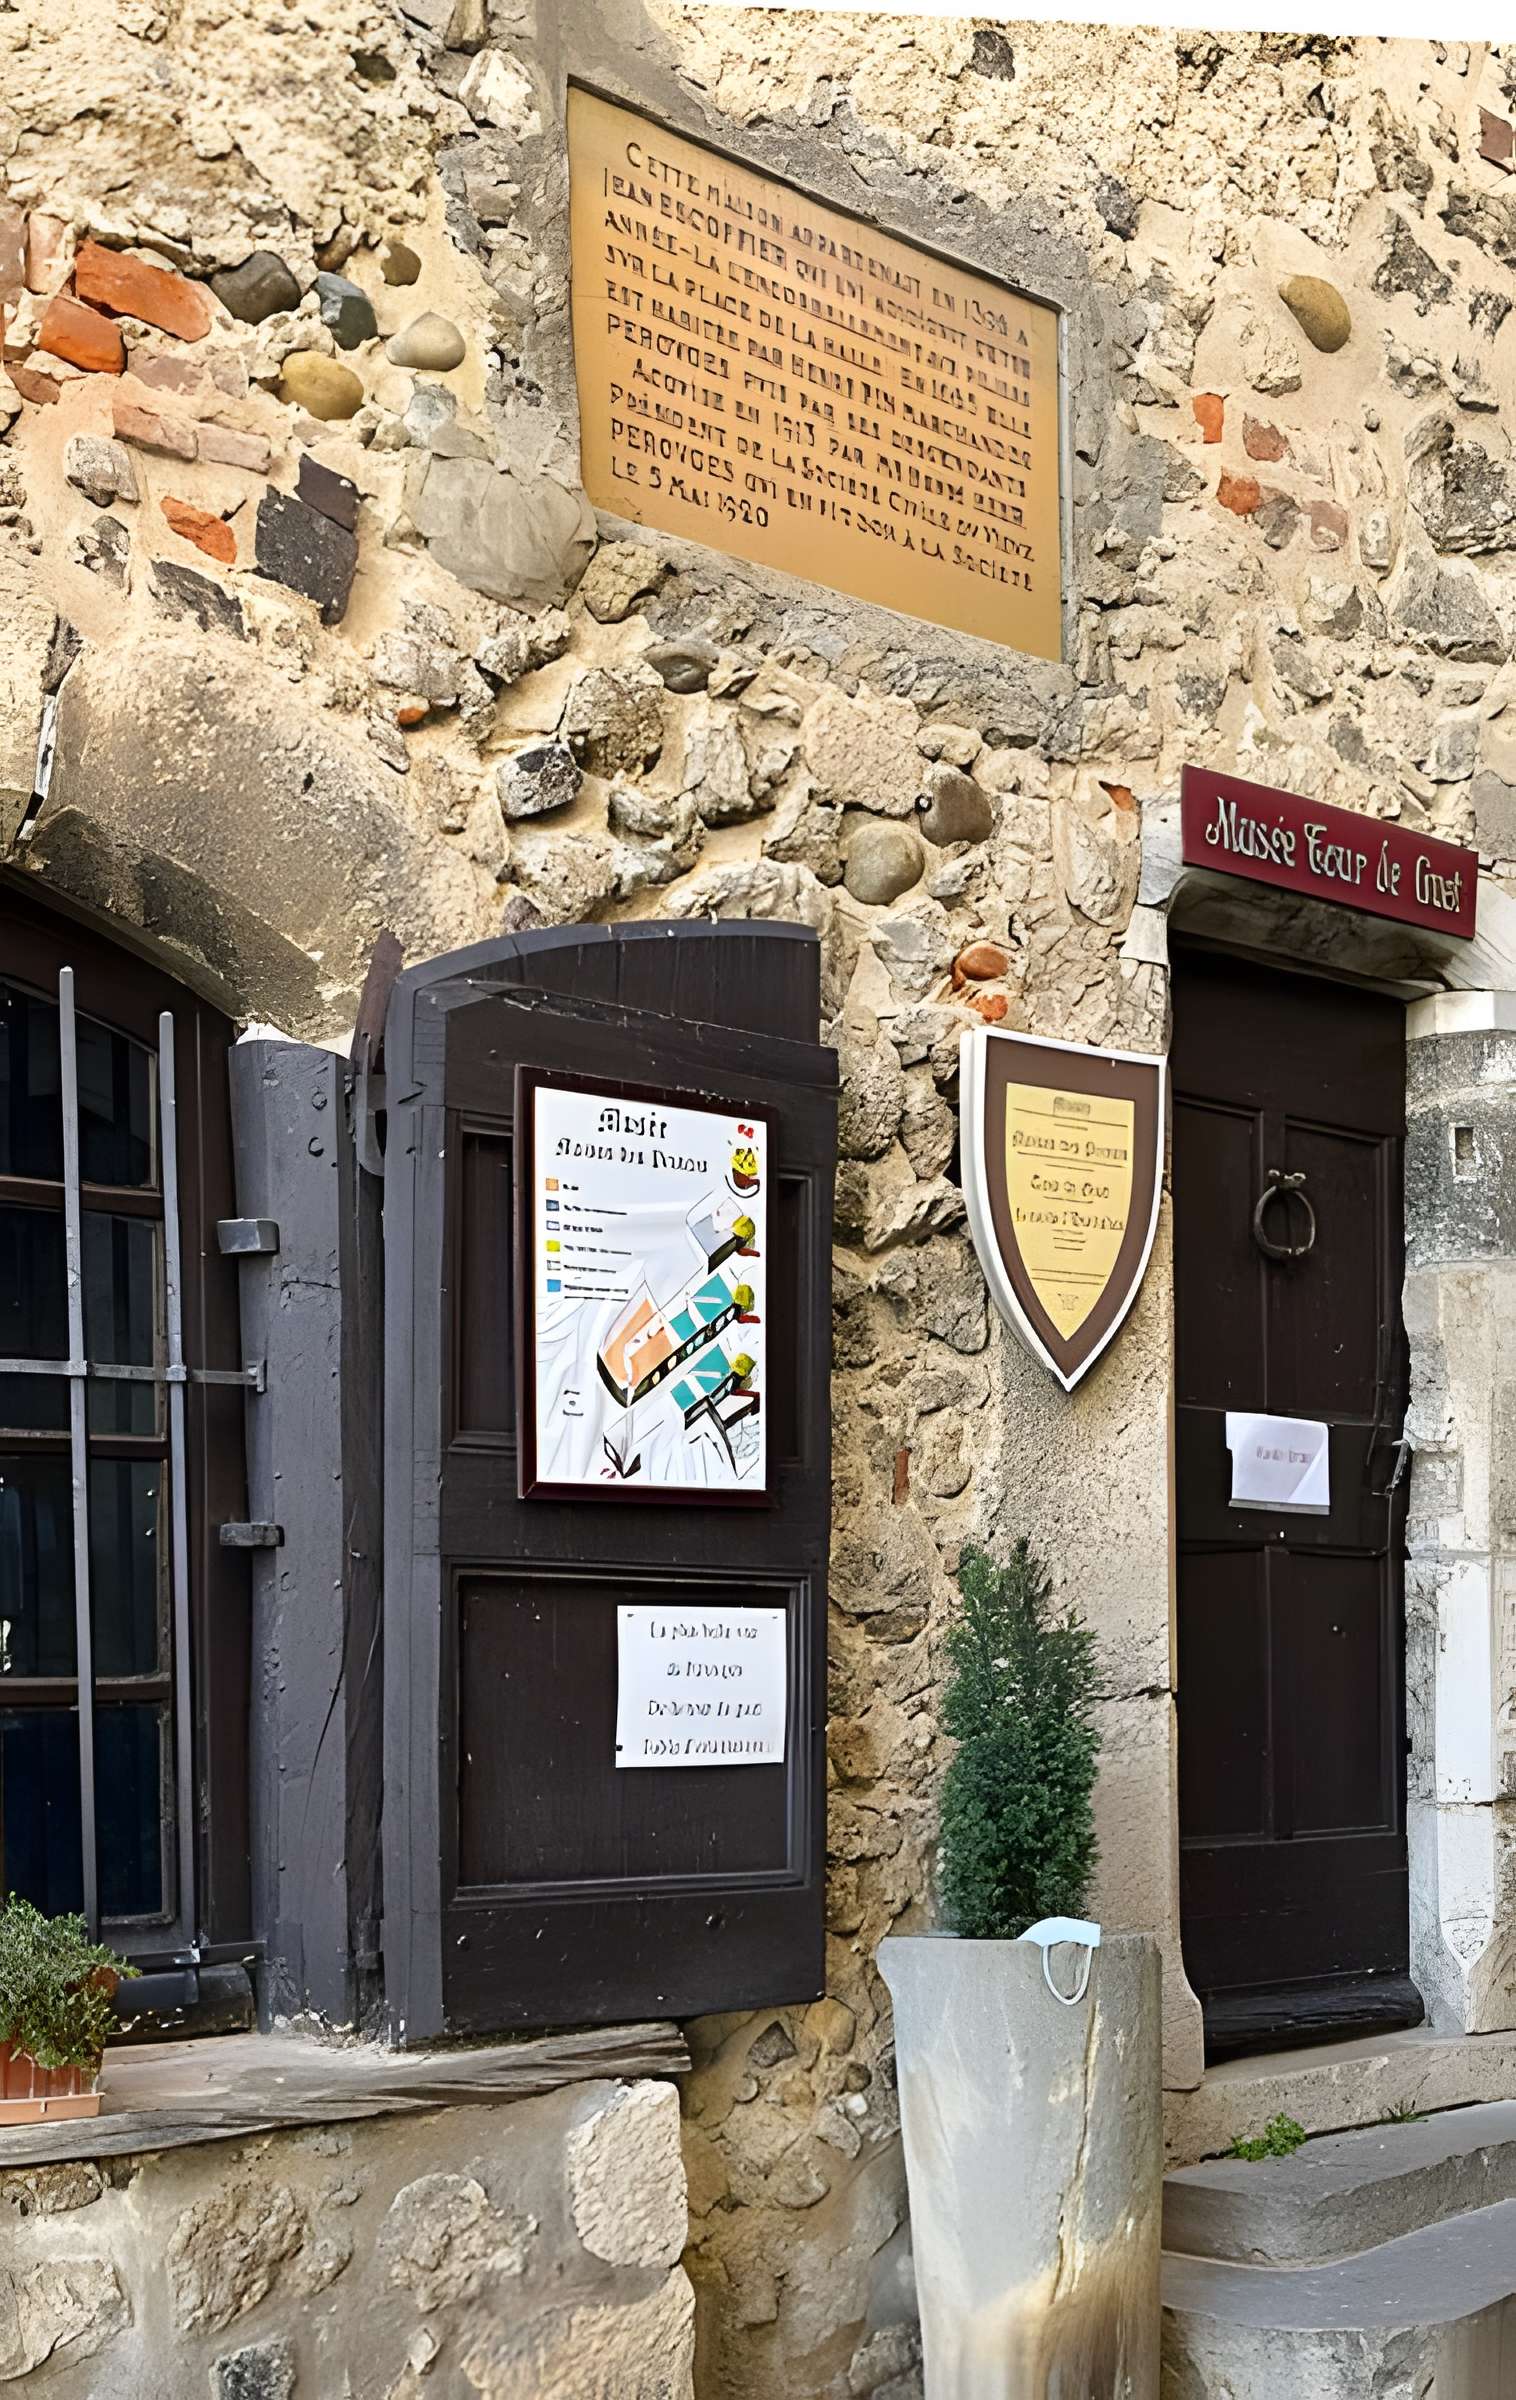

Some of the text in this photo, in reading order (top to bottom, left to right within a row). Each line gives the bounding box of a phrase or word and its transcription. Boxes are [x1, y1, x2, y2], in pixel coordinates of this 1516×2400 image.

[625, 141, 699, 196] CETTE
[660, 192, 786, 270] ESCOFFIER
[1205, 796, 1296, 867] Musée
[1376, 840, 1400, 896] de
